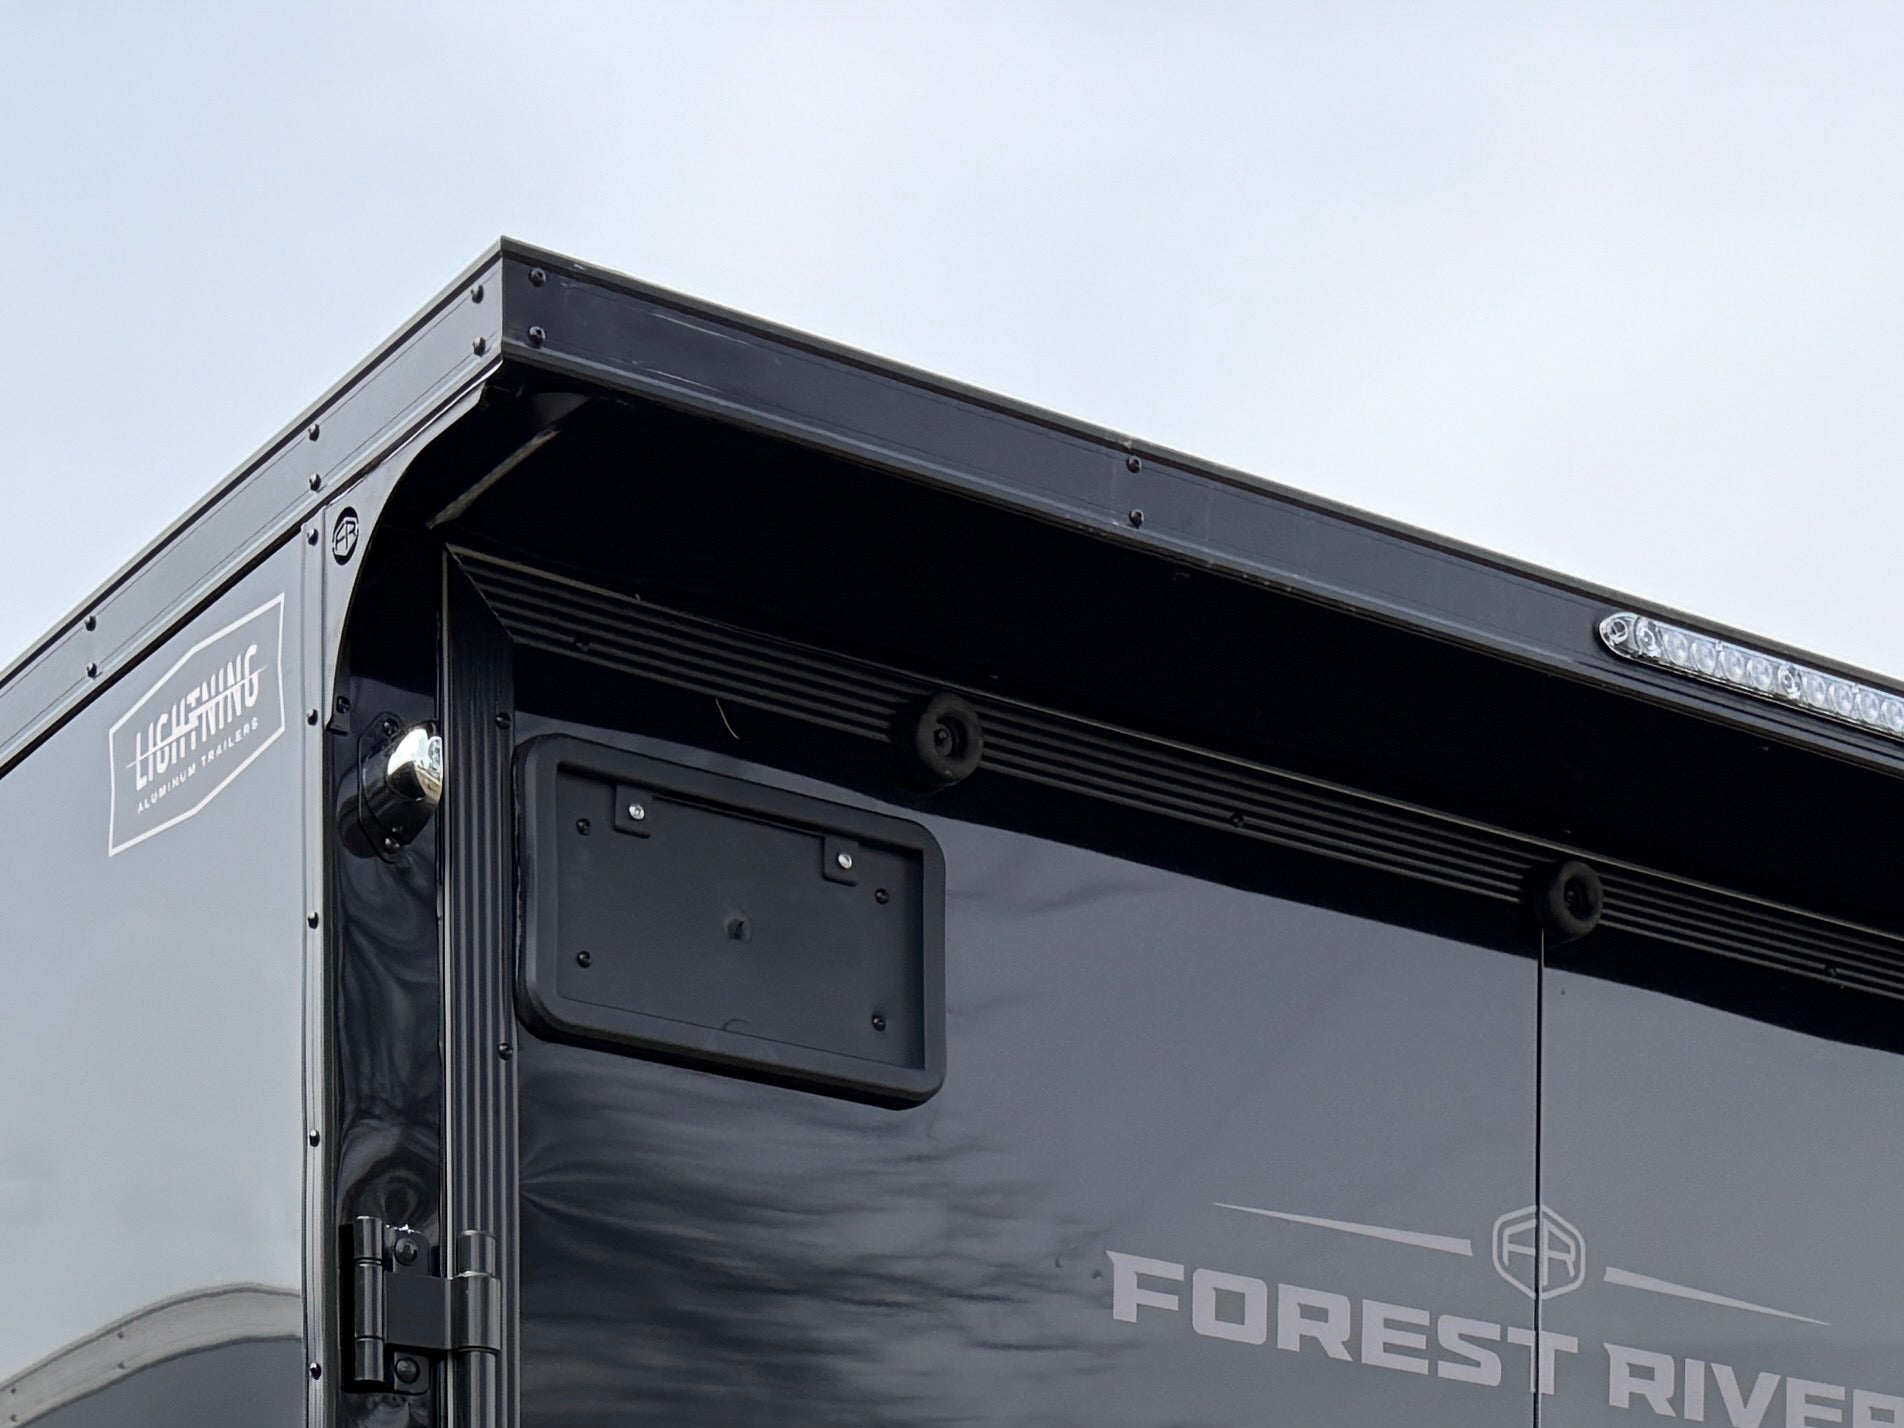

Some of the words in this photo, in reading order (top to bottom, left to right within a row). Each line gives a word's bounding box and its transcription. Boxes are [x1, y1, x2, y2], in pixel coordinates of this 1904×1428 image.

[135, 643, 259, 791] LIGHTNING
[137, 764, 197, 813] ALUMINUM
[200, 717, 258, 767] TRAILERS
[1104, 1249, 1579, 1397] FOREST
